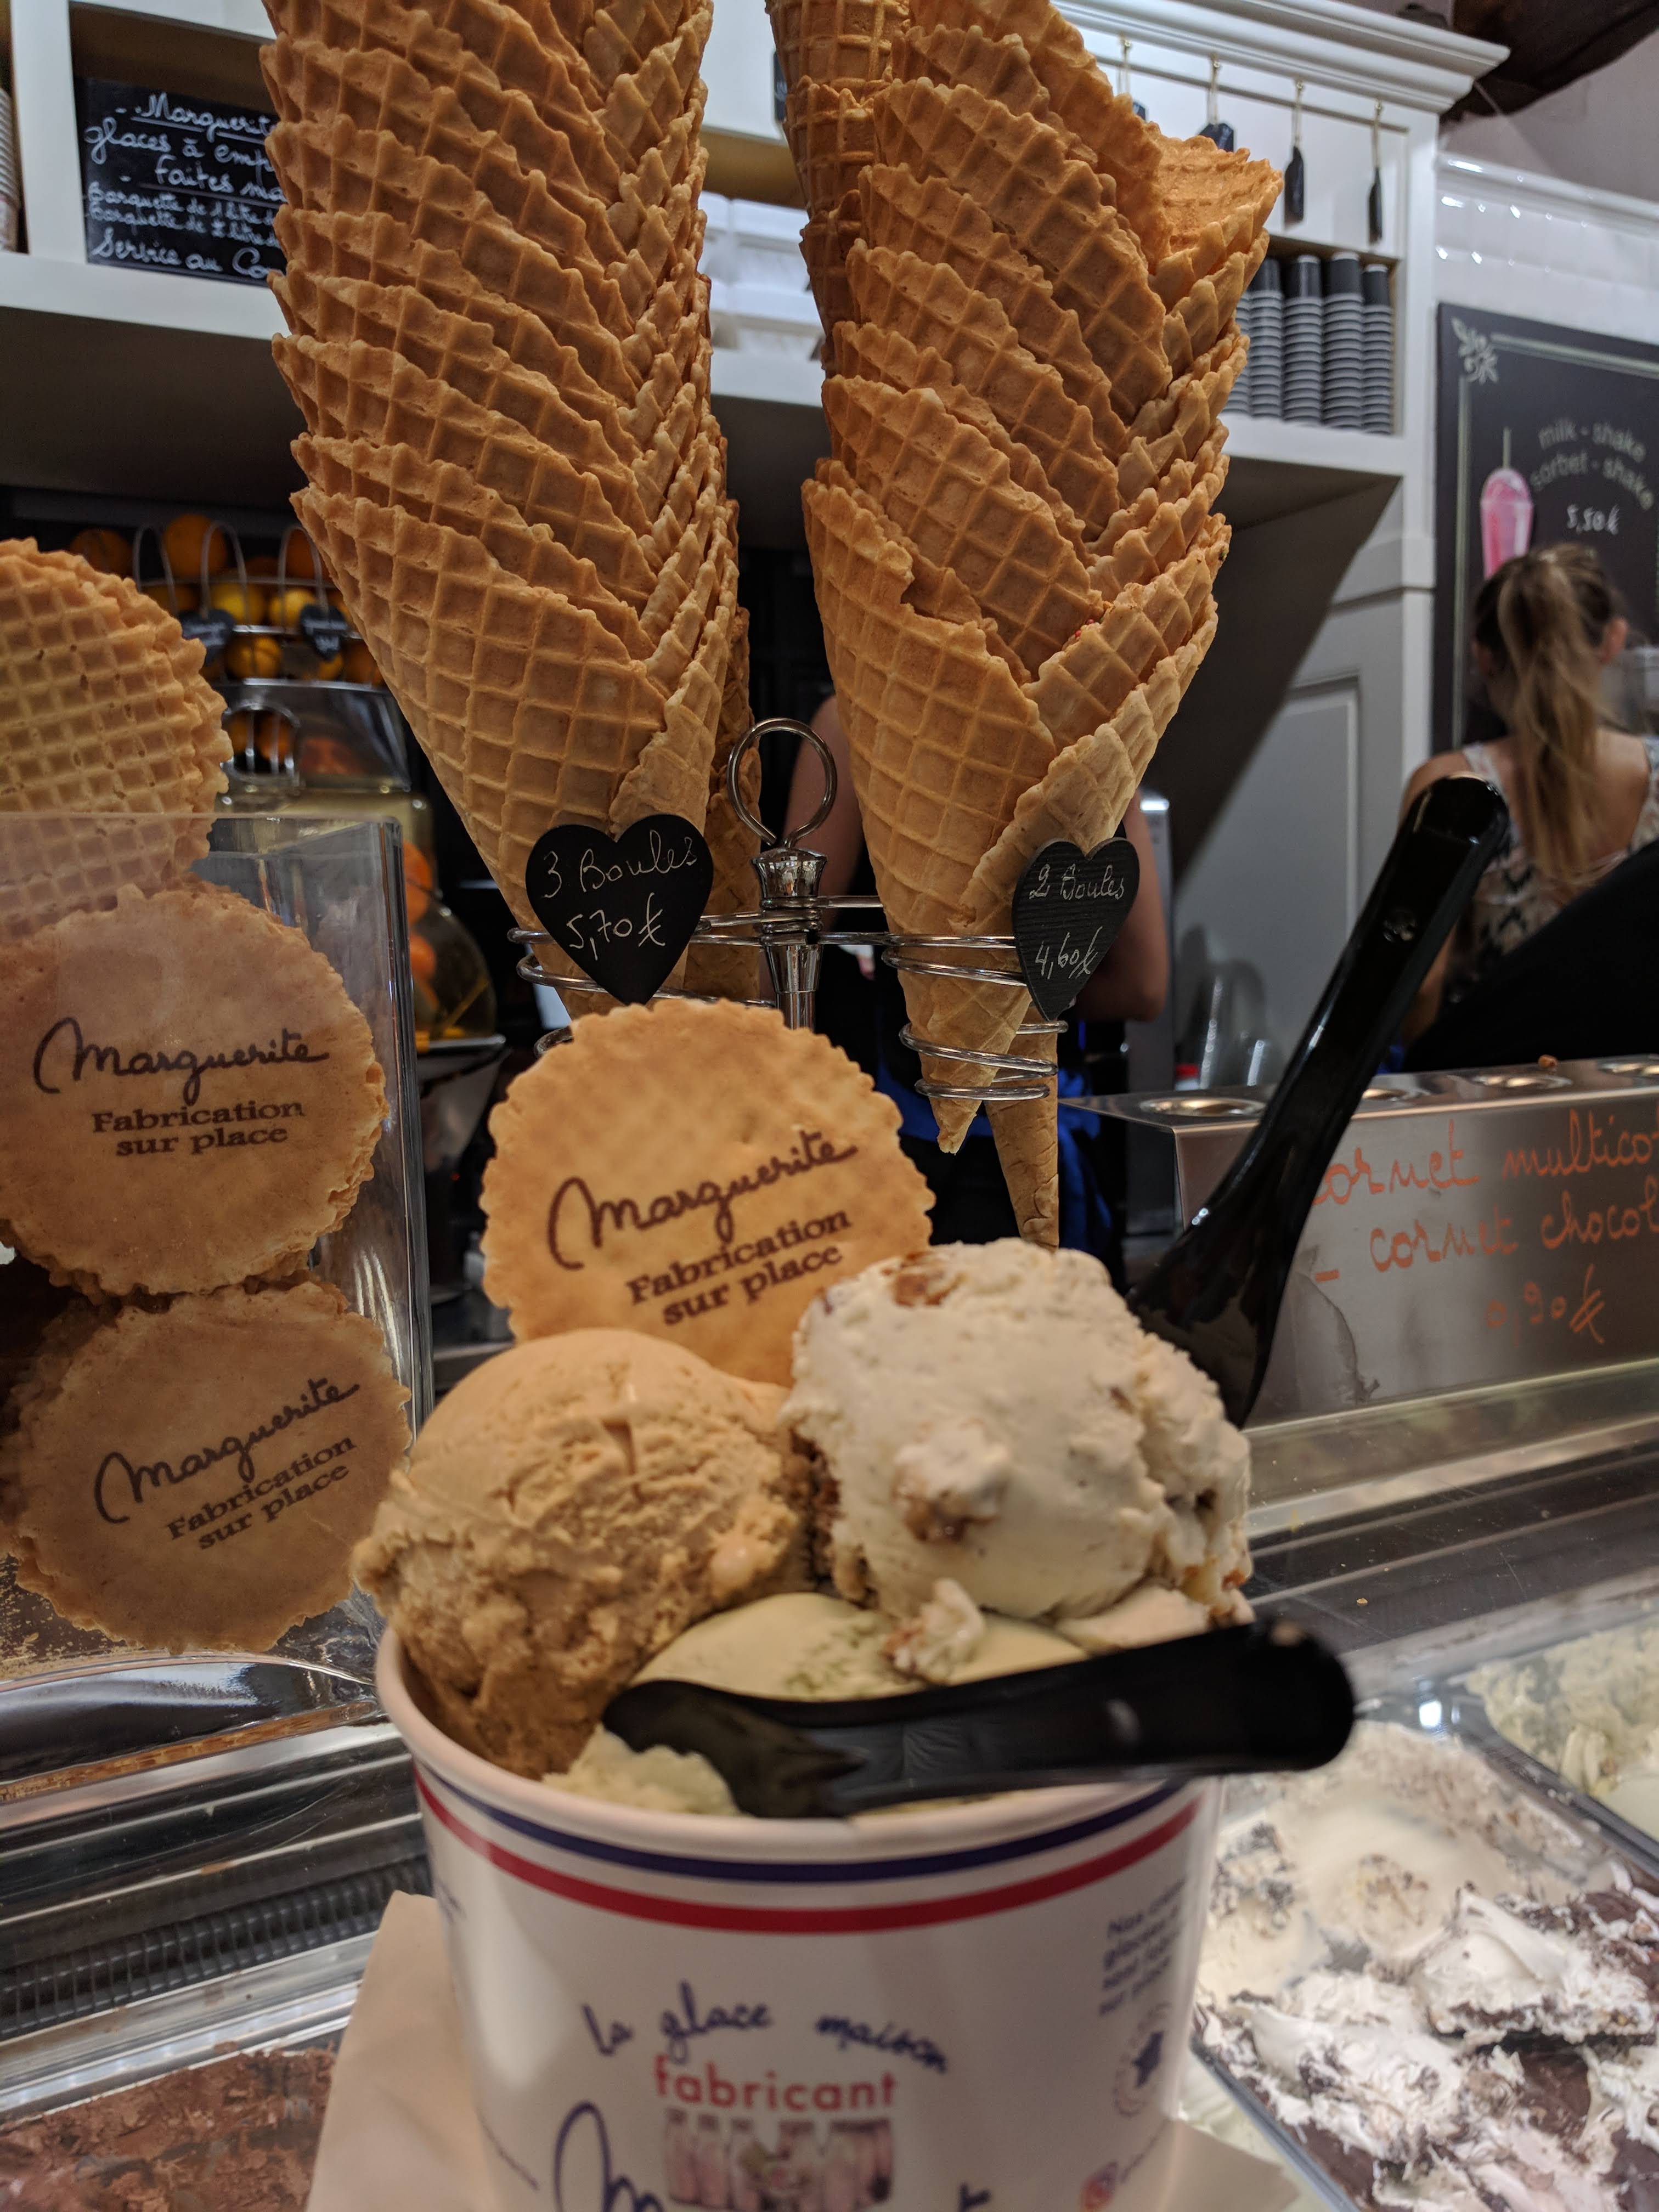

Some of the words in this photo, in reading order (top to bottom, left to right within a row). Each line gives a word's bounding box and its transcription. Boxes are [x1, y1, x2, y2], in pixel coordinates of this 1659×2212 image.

[135, 92, 276, 143] Marguerit
[215, 144, 275, 186] emp
[240, 182, 287, 203] ma
[232, 247, 270, 279] Co
[1530, 449, 1589, 492] sorbet
[543, 850, 562, 898] 3
[580, 829, 697, 893] Boules
[1029, 864, 1050, 900] 2
[1060, 864, 1125, 900] Boules
[566, 891, 666, 961] 5,70€
[1035, 926, 1103, 980] 4,60€
[33, 1017, 329, 1106] Marguerite
[92, 1098, 306, 1133] Fabrication
[116, 1133, 179, 1156] sur
[191, 1124, 289, 1154] place
[1312, 1118, 1482, 1206] ornet
[546, 1129, 858, 1271] Marguerite
[625, 1210, 852, 1306] Fabrication
[1371, 1203, 1519, 1273] cornet
[662, 1282, 730, 1325] sur
[738, 1246, 843, 1305] place
[94, 1378, 360, 1525] Marguerite
[167, 1436, 357, 1541] Fabrication
[198, 1513, 252, 1550] sur
[261, 1465, 350, 1523] place
[661, 1980, 772, 2064] glace
[653, 2054, 896, 2112] fabricant
